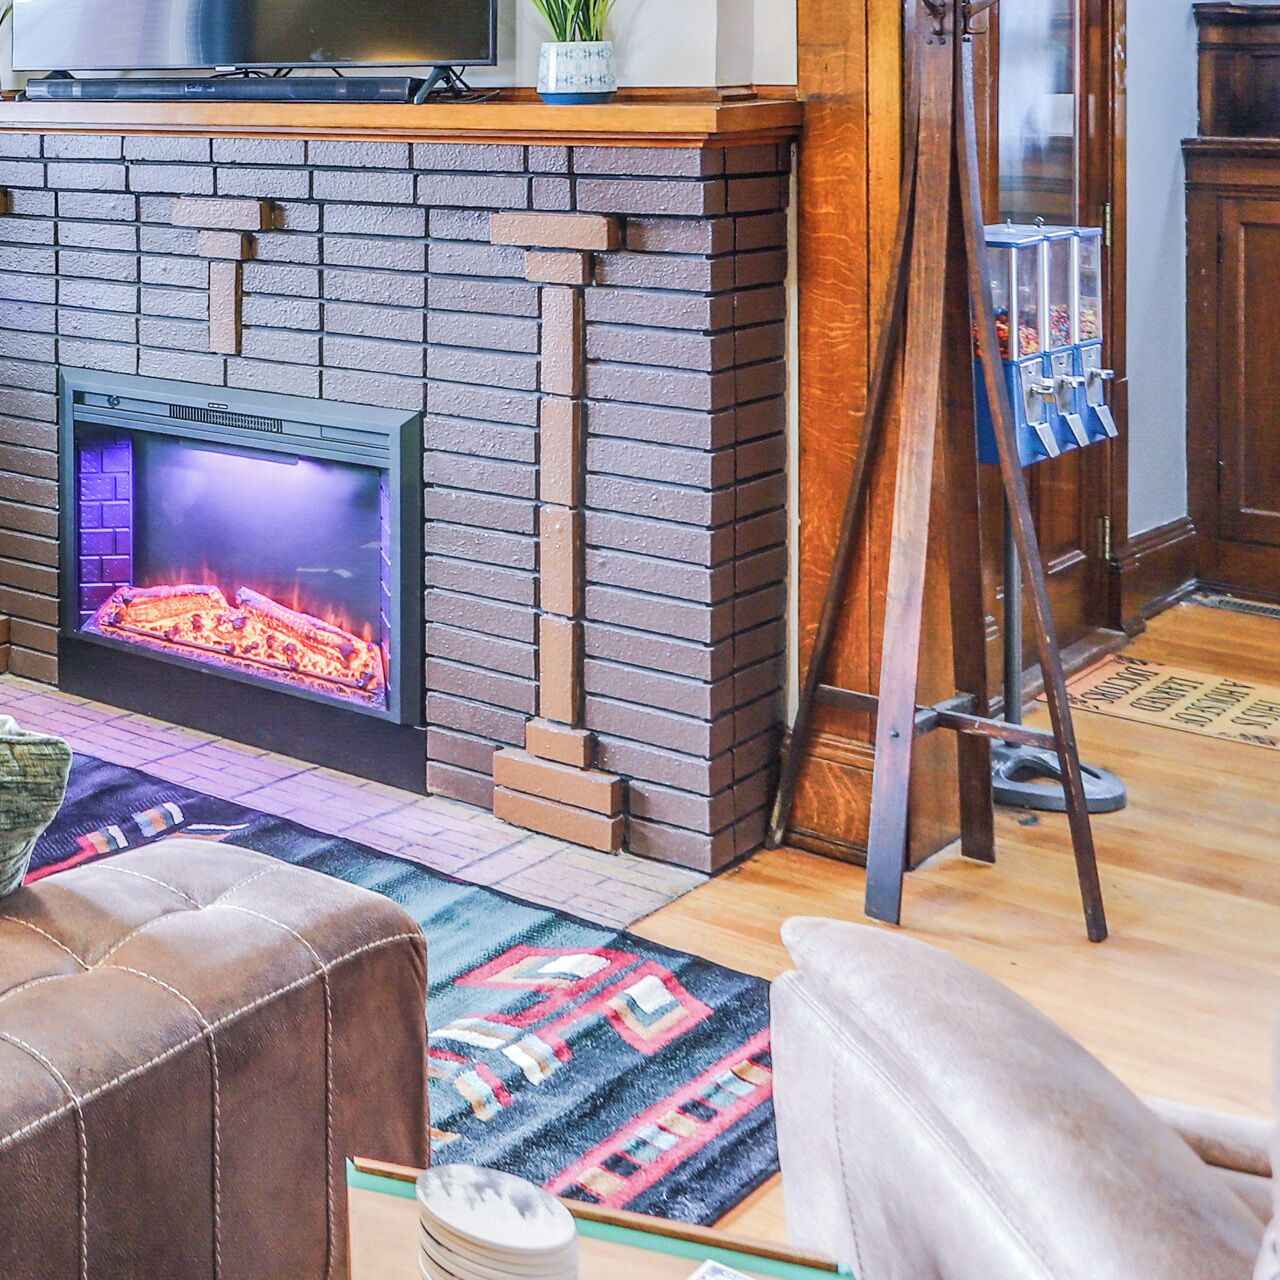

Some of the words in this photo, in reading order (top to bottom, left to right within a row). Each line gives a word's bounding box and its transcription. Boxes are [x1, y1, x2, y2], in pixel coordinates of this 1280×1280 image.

[1081, 666, 1159, 704] DOCTORS
[1130, 676, 1204, 712] LEARNED
[1220, 679, 1255, 690] A
[1185, 687, 1250, 716] HOUSE
[1170, 711, 1214, 728] OF
[1231, 716, 1272, 729] IS
